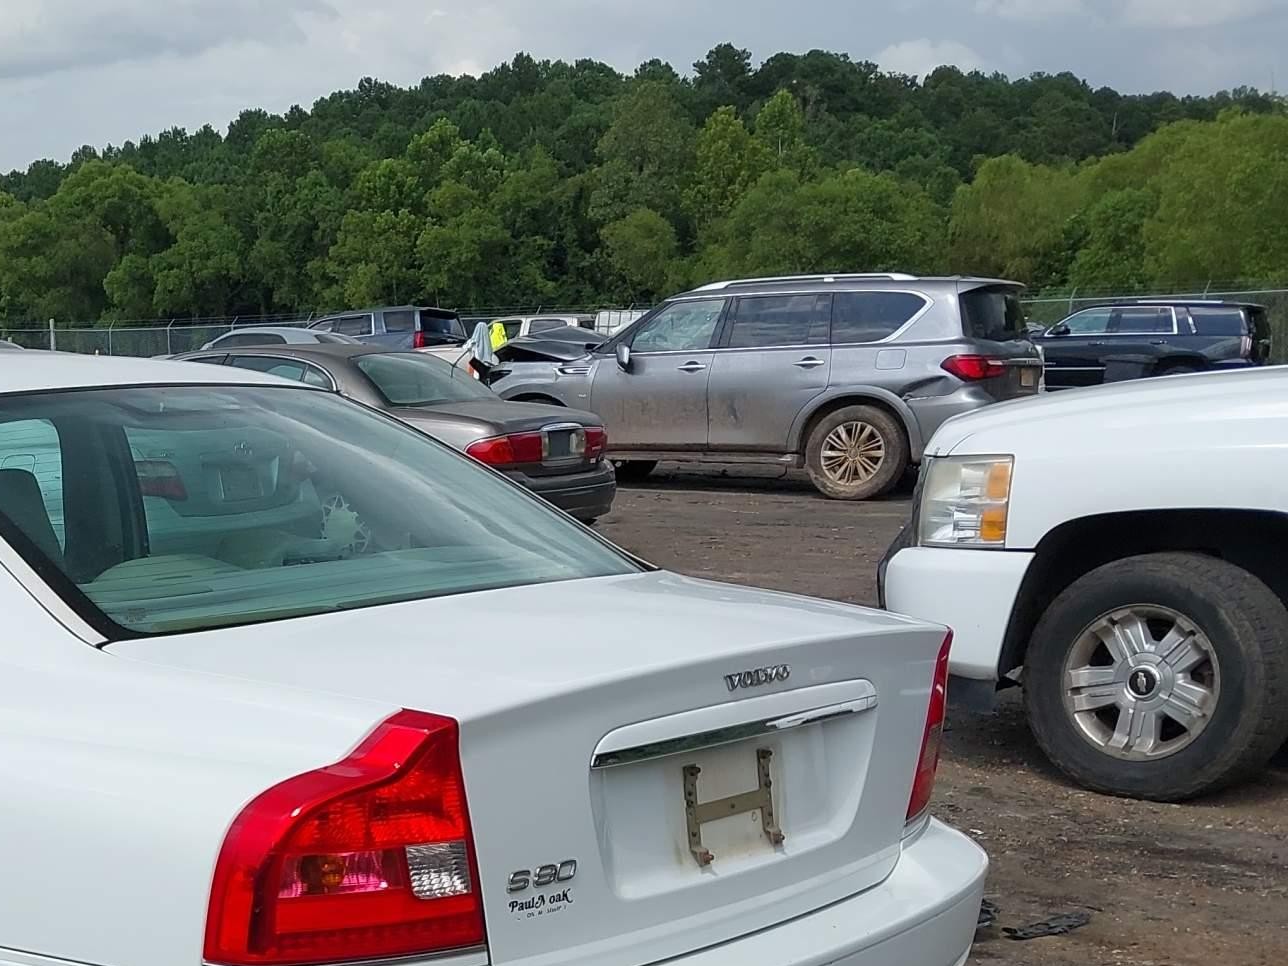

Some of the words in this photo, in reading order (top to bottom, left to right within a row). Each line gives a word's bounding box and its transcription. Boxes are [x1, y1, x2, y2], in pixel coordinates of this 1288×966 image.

[724, 664, 790, 692] VOLVO
[507, 859, 577, 892] S80
[509, 897, 535, 912] Paul
